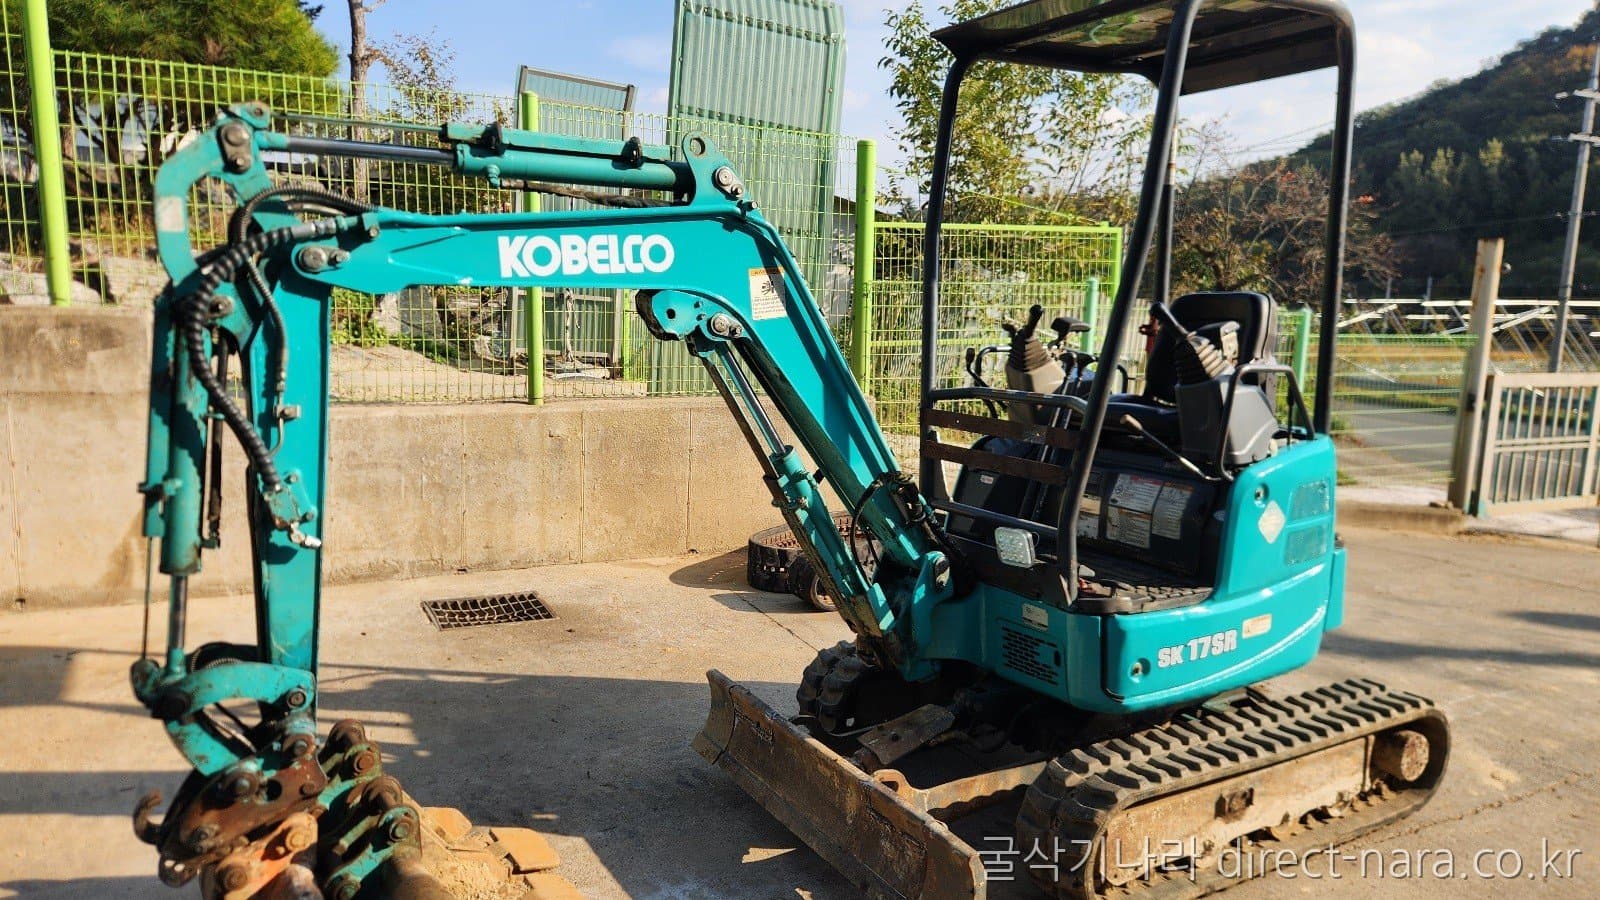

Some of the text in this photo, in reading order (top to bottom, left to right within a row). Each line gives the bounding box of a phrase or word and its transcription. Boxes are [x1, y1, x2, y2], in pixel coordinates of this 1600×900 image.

[498, 234, 675, 278] KOBELCO
[1158, 629, 1237, 668] SK 17SR
